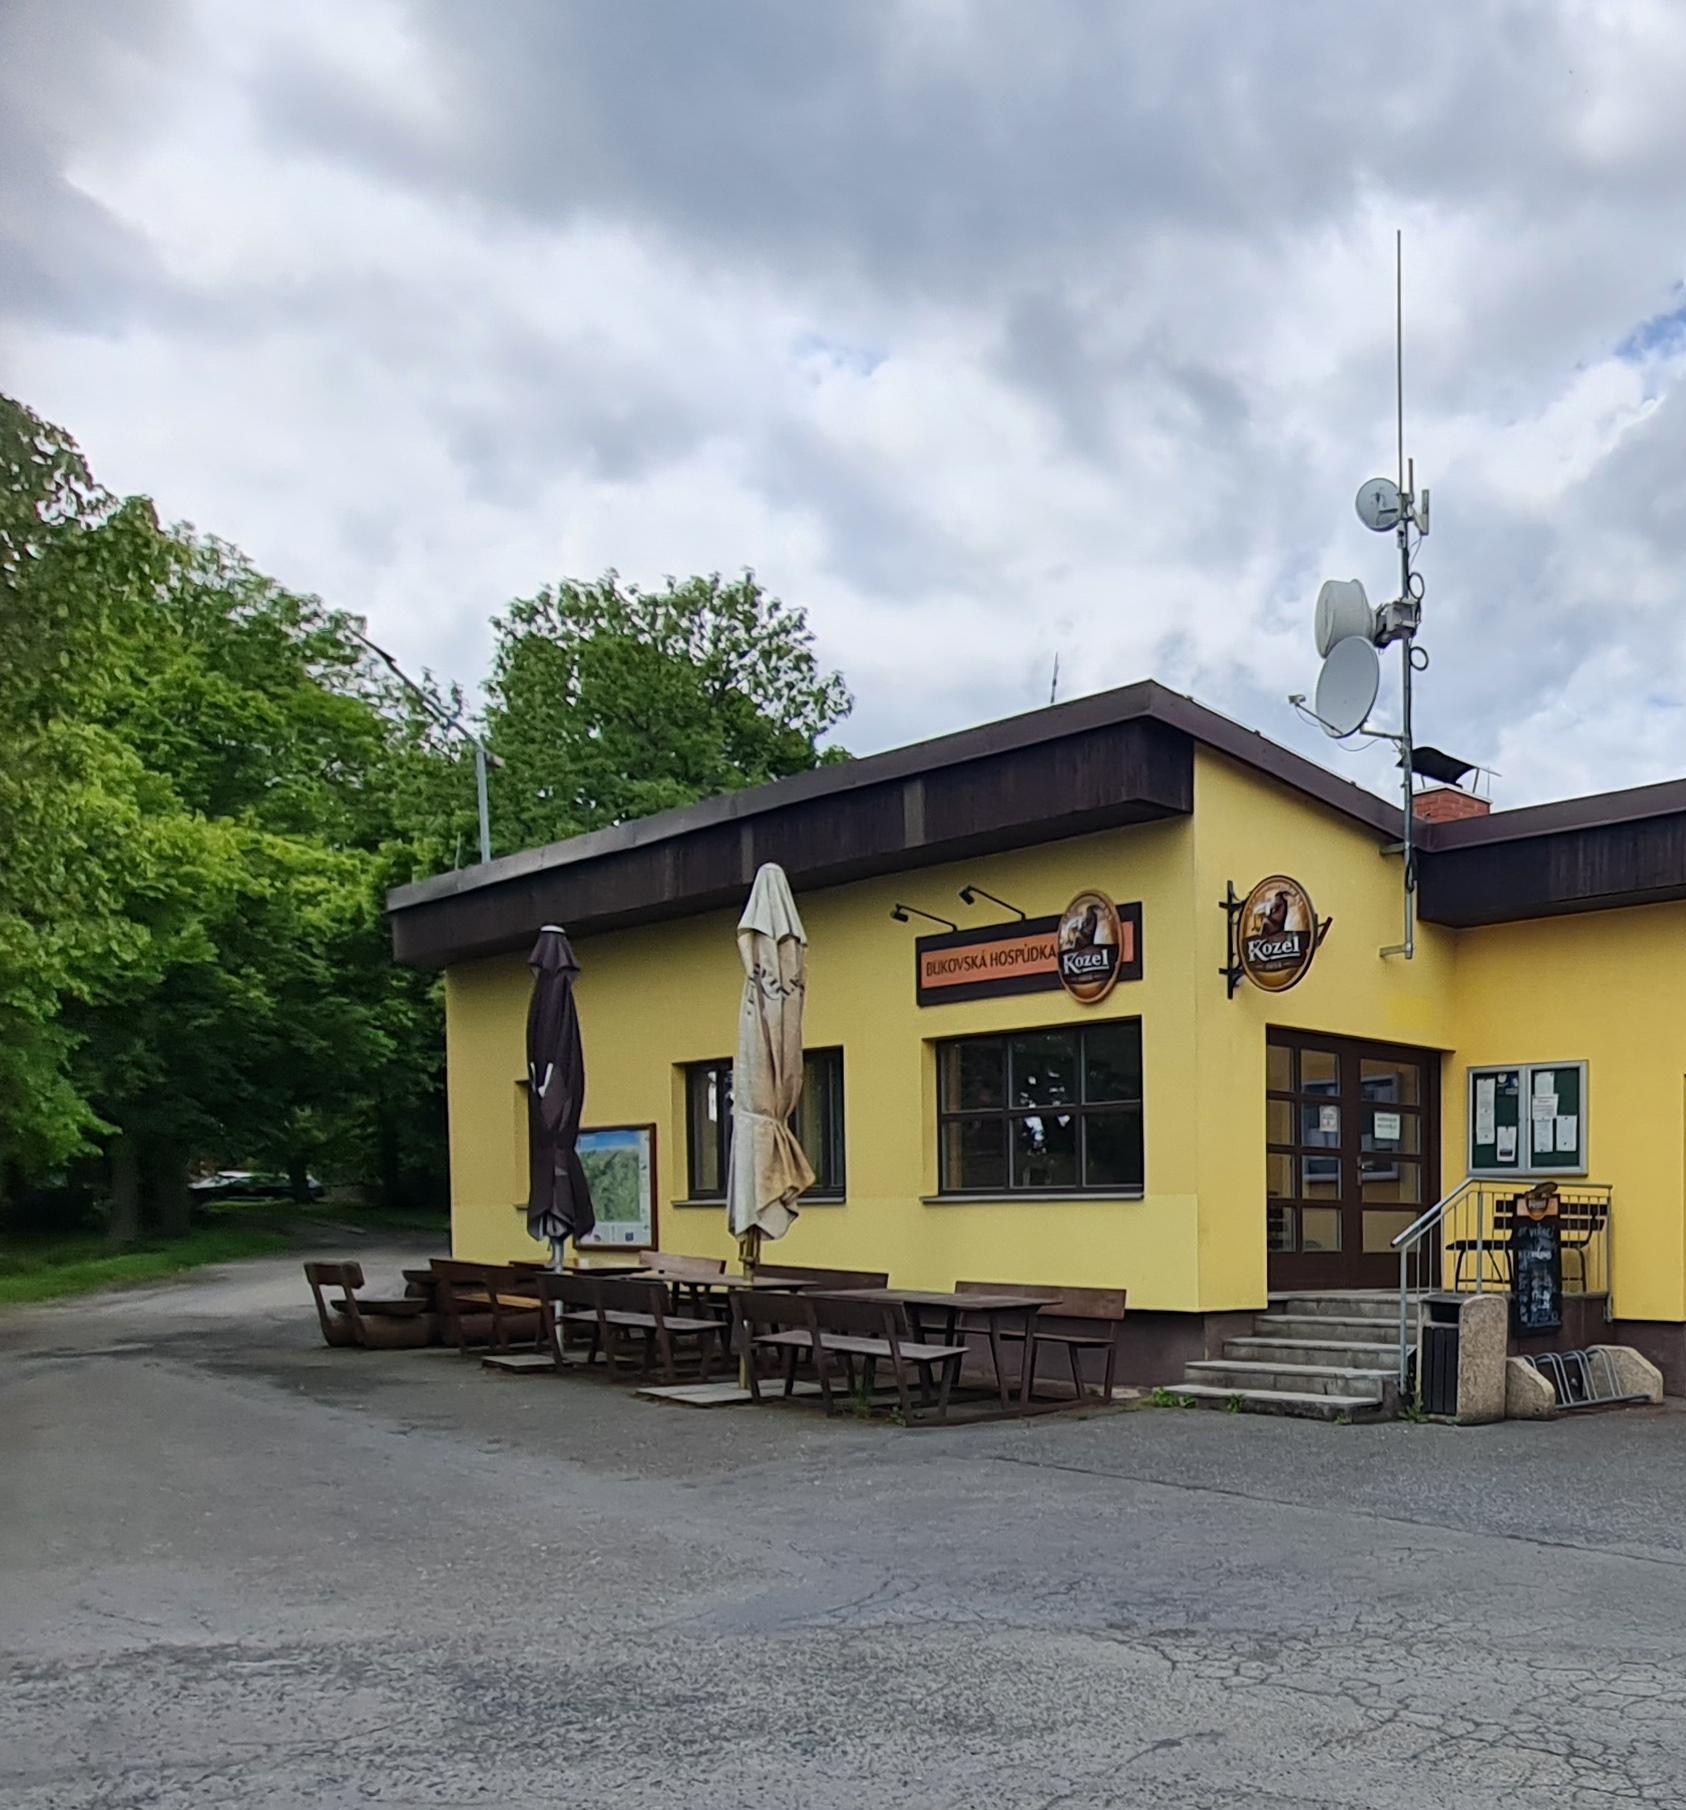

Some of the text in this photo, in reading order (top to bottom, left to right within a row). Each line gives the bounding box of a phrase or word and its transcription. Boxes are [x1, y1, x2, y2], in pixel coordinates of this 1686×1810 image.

[1248, 936, 1300, 961] Kozel
[926, 950, 987, 976] BUKOVSKÁ
[1063, 949, 1109, 974] Kozel
